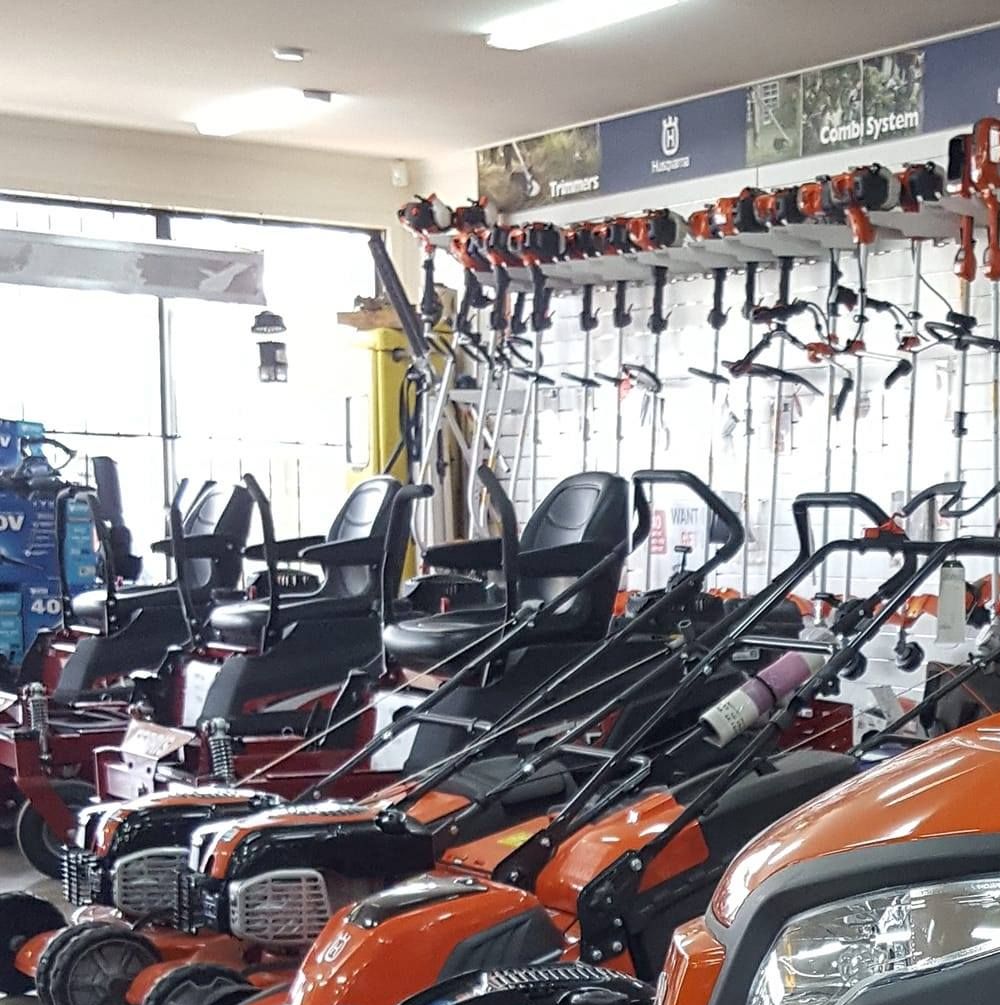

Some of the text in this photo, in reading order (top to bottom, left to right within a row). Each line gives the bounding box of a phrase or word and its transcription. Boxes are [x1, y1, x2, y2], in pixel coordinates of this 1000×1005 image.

[820, 111, 919, 144] Combi System
[651, 156, 691, 174] Husqvarna
[549, 175, 600, 198] Trimmers
